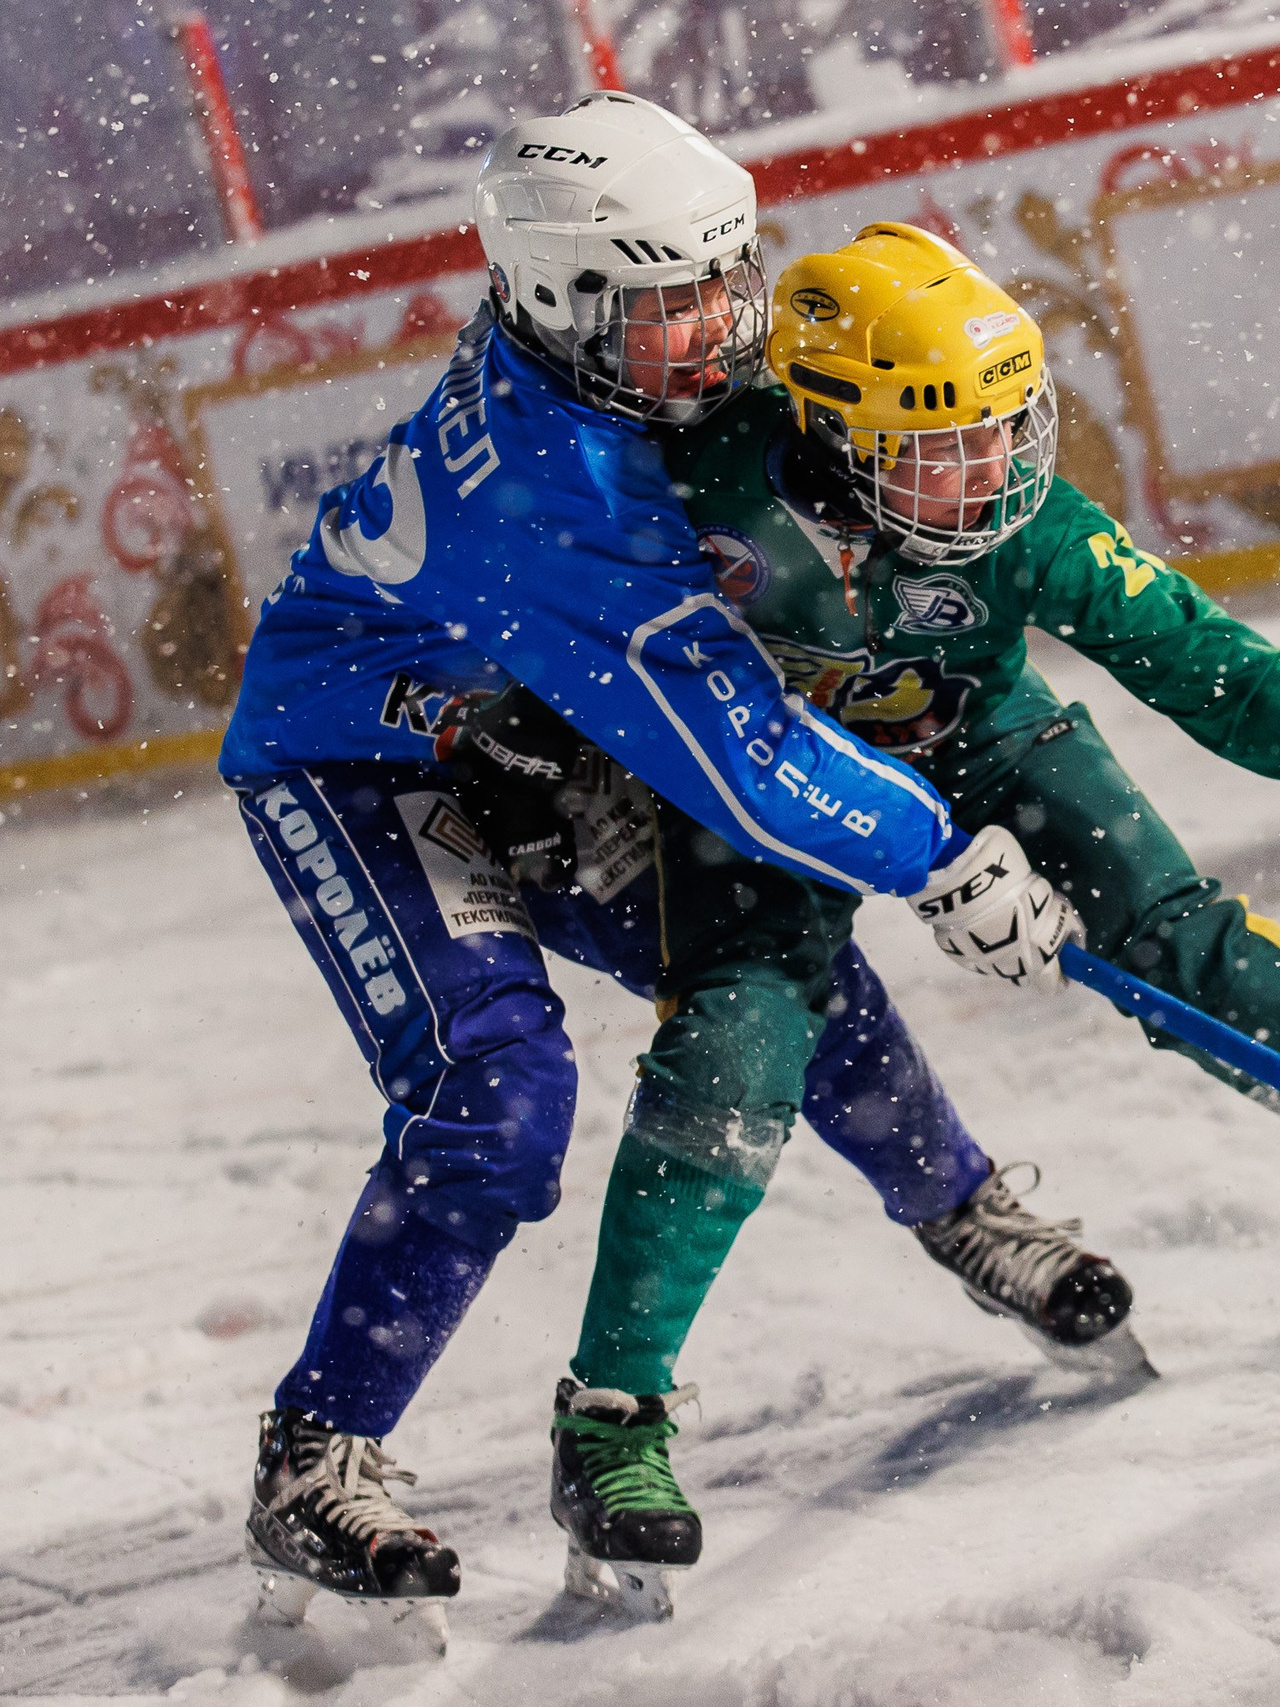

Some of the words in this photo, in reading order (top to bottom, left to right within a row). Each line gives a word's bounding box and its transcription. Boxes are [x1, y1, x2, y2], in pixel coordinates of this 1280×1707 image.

[517, 143, 609, 169] CCM
[702, 213, 746, 243] CCM
[982, 352, 1031, 384] CCM
[682, 641, 878, 838] КОРОЛЁВ
[508, 832, 562, 857] CARBON
[470, 872, 487, 887] АО
[256, 781, 406, 1016] КОРОЛЁВ
